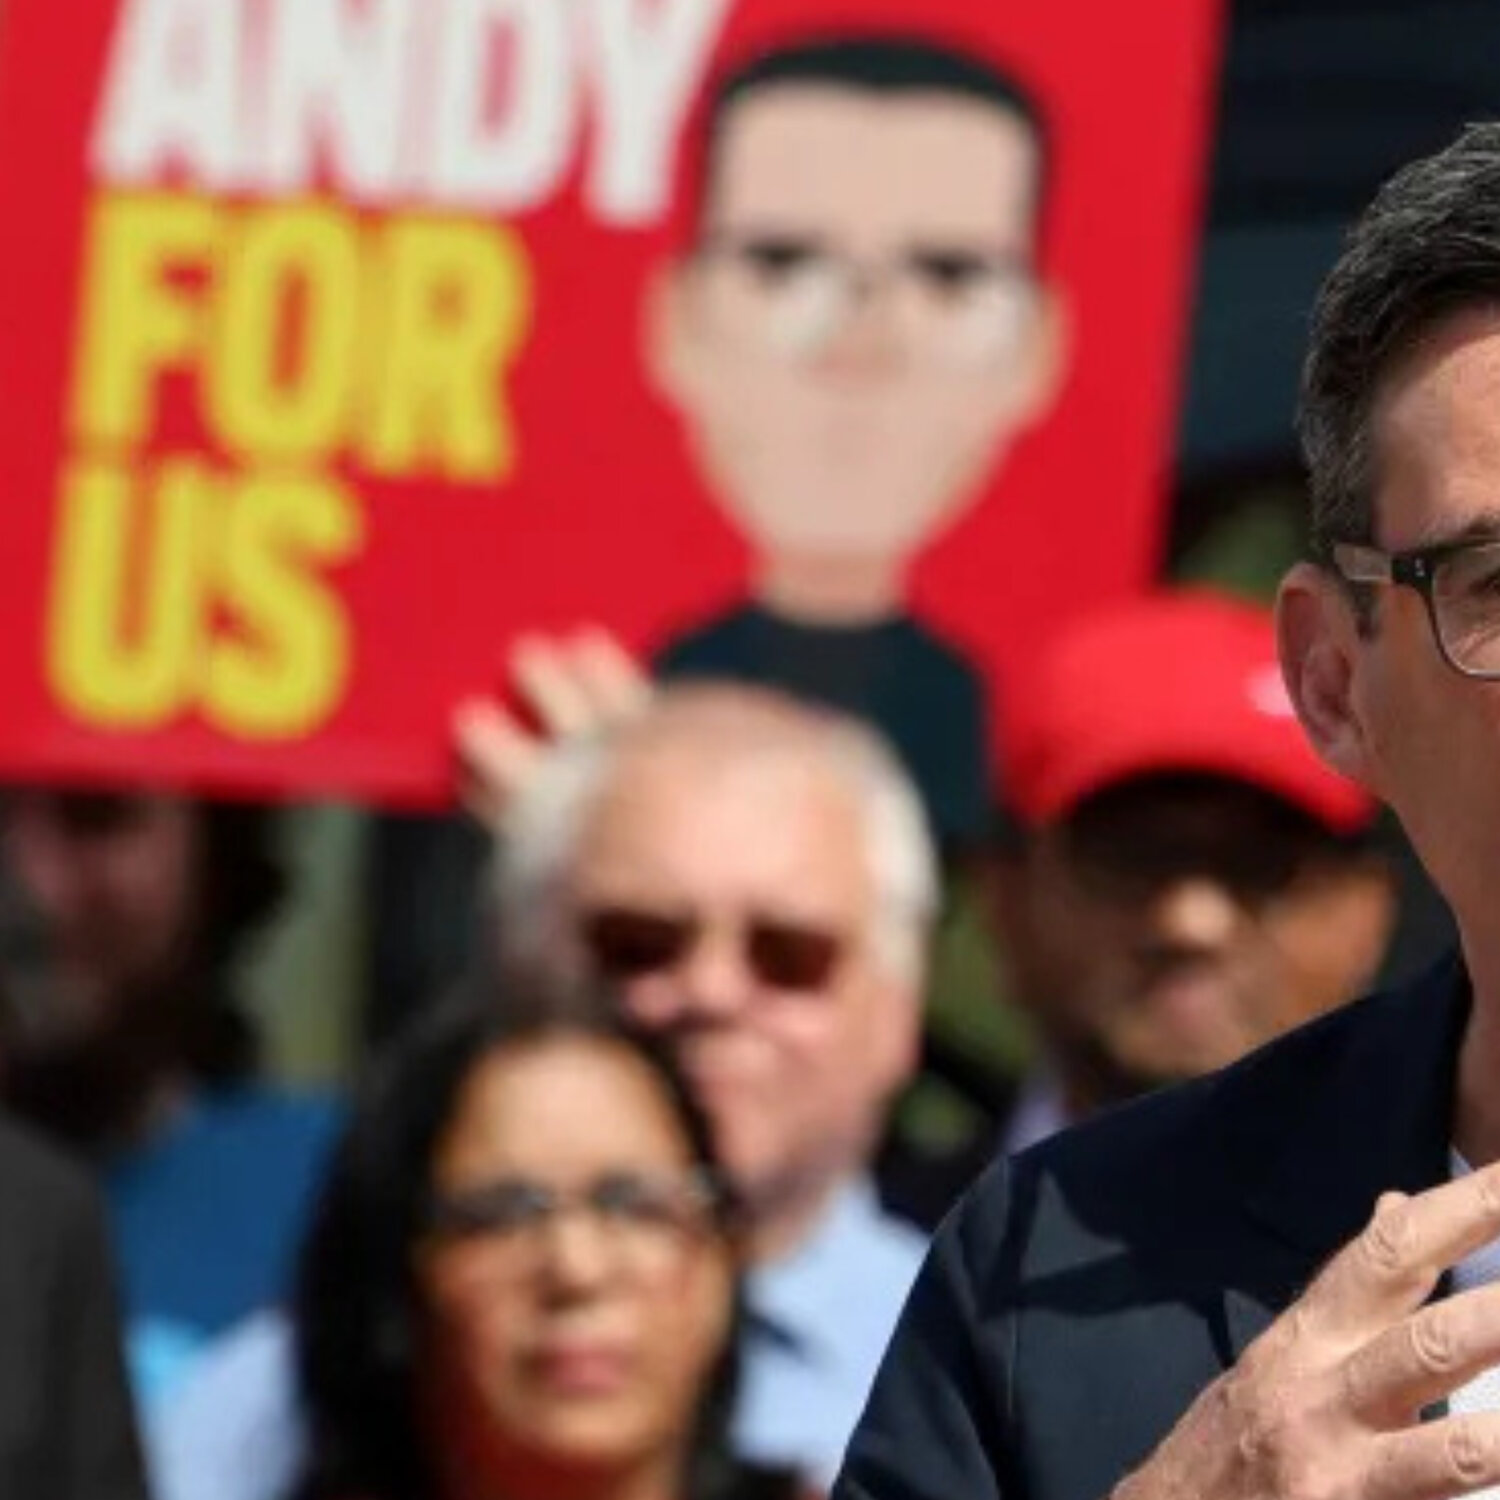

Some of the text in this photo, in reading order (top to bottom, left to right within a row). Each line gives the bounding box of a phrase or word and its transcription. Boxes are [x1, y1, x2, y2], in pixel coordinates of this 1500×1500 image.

[88, 0, 735, 228] ANDY
[70, 186, 533, 486] FOR
[46, 452, 364, 742] US
